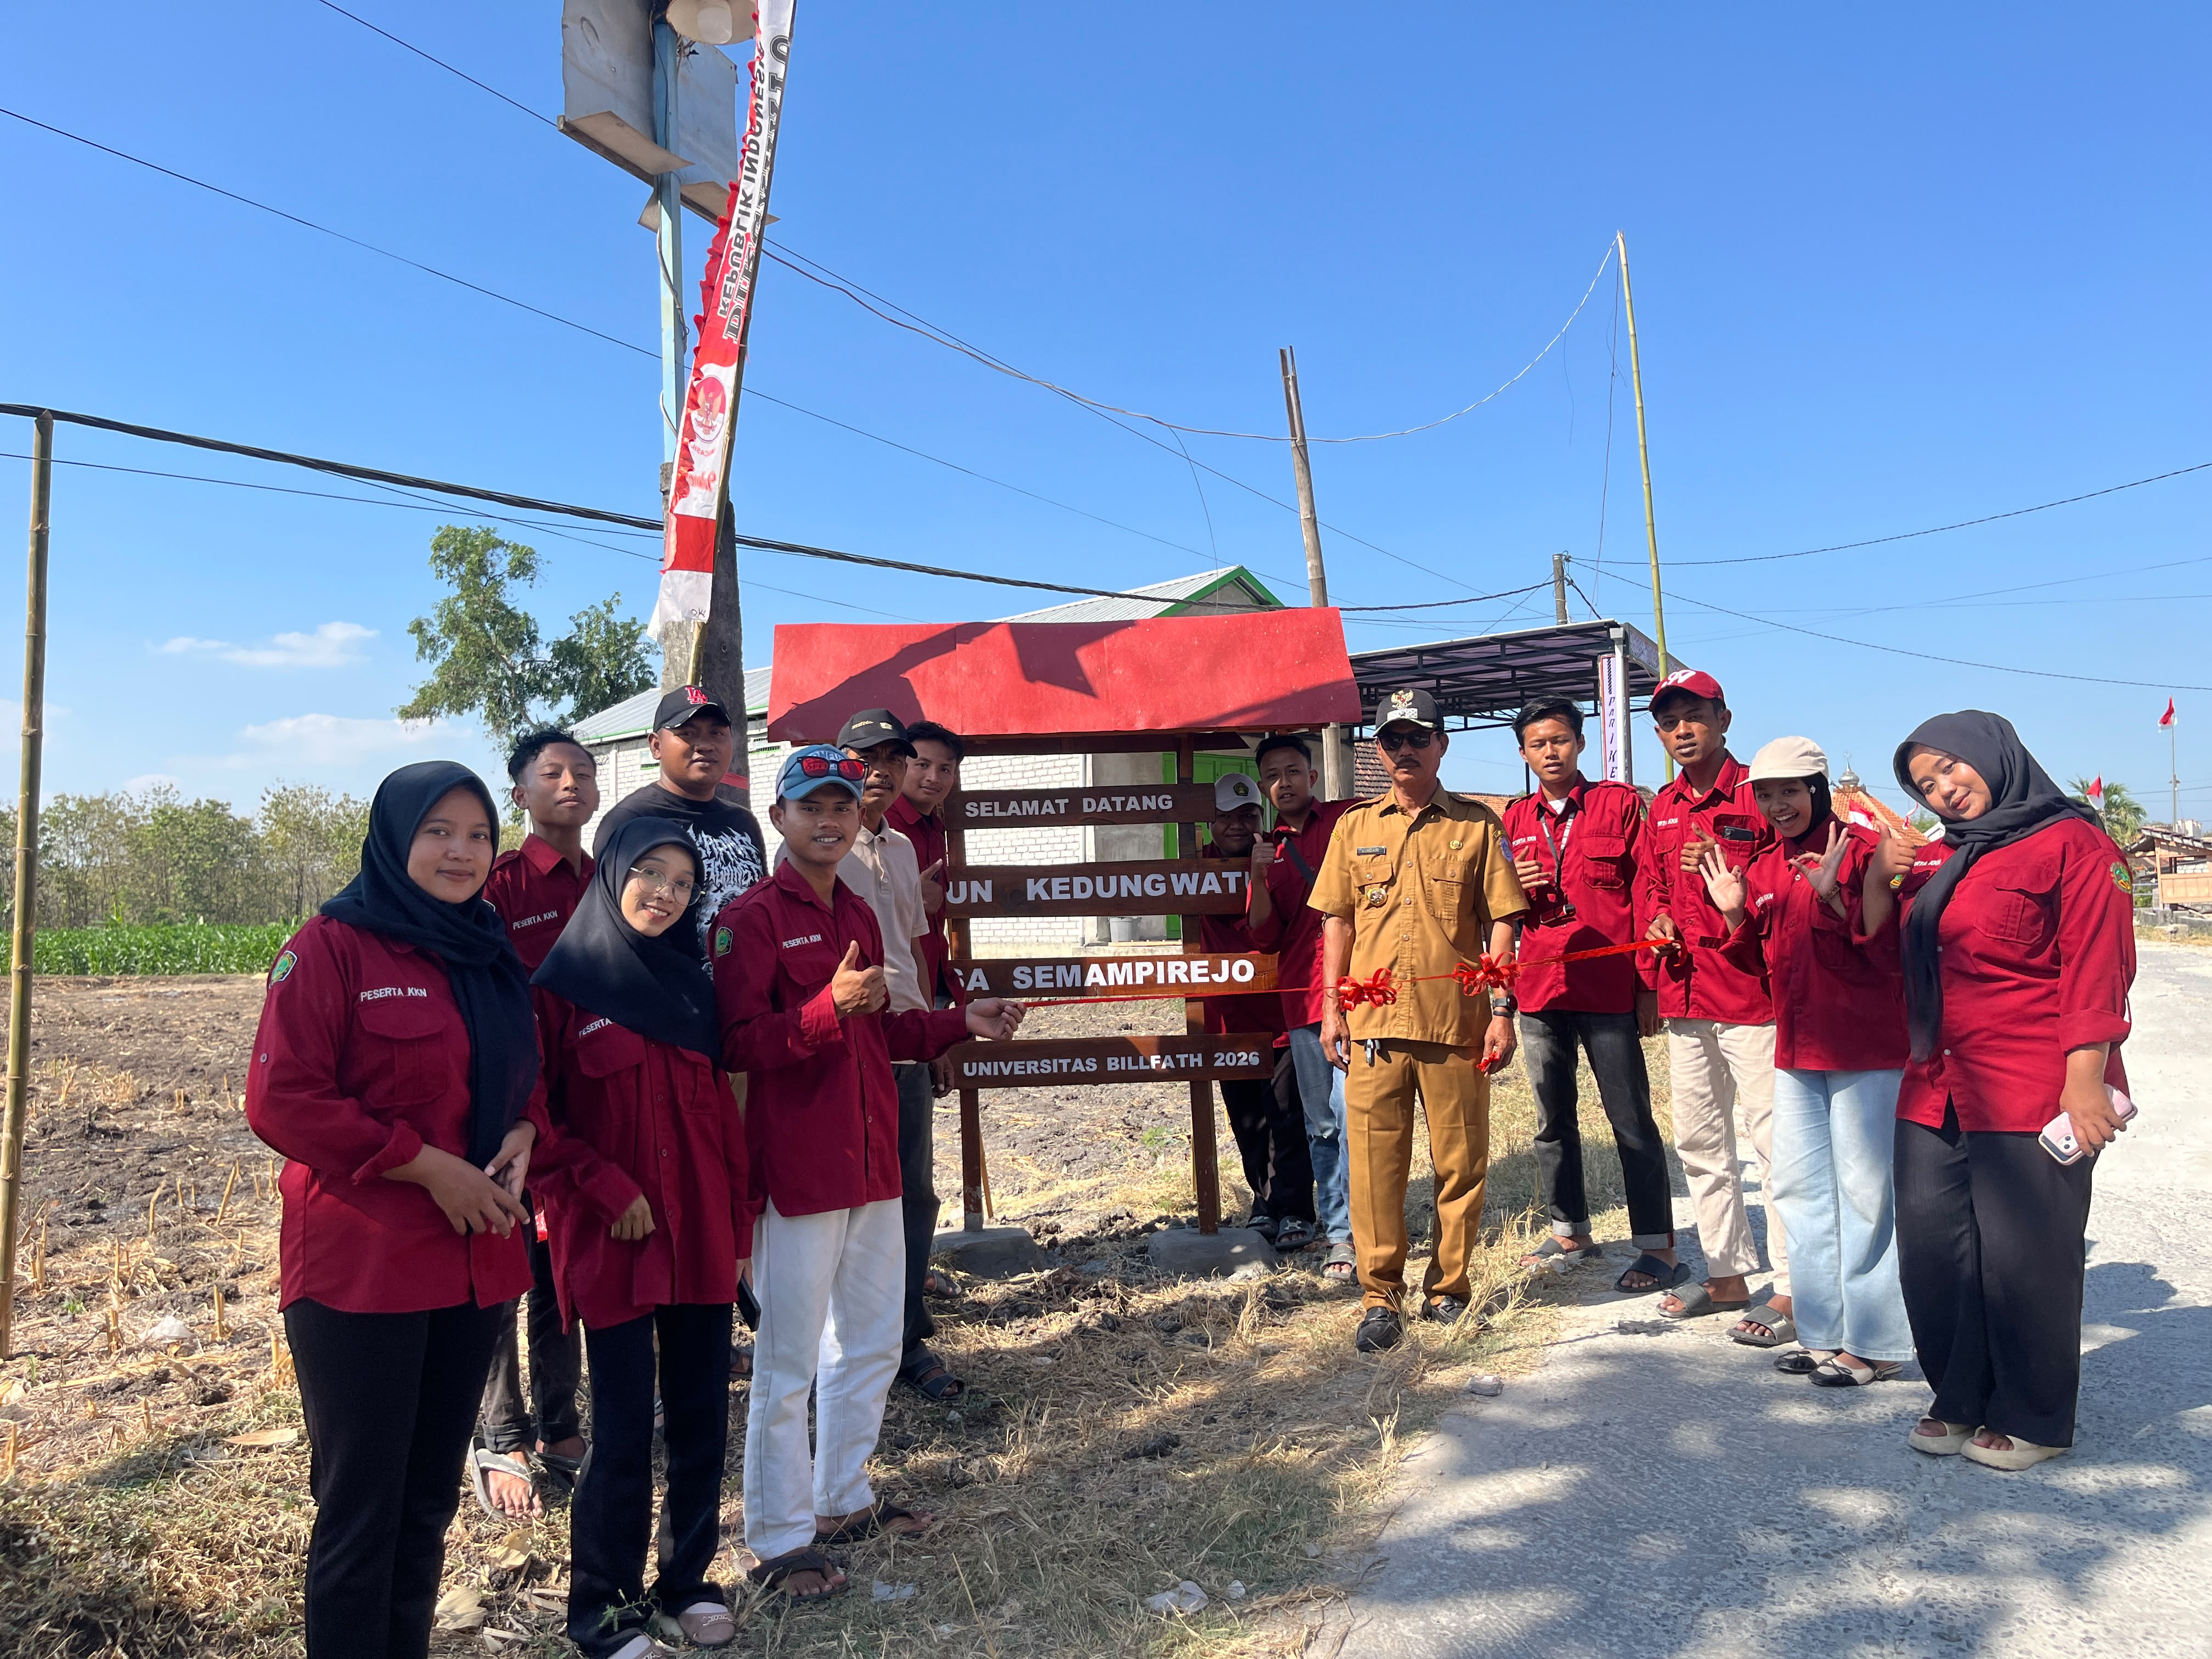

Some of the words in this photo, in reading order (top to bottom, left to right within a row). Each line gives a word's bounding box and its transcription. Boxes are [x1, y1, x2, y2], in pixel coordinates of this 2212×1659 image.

[685, 687, 708, 704] LA
[965, 799, 1069, 817] SELAMAT
[1082, 794, 1173, 813] DATANG
[513, 915, 542, 930] PESERTA
[543, 910, 558, 920] KKN
[782, 936, 809, 950] PESERTA
[809, 934, 822, 943] KKN
[1013, 959, 1255, 989] SEMAMPIREJO
[360, 987, 404, 1002] PESERTA
[408, 987, 427, 997] KKN
[963, 1057, 1097, 1076] UNIVERSITAS
[1107, 1053, 1203, 1070] BILLFATH
[1214, 1051, 1260, 1066] 2026
